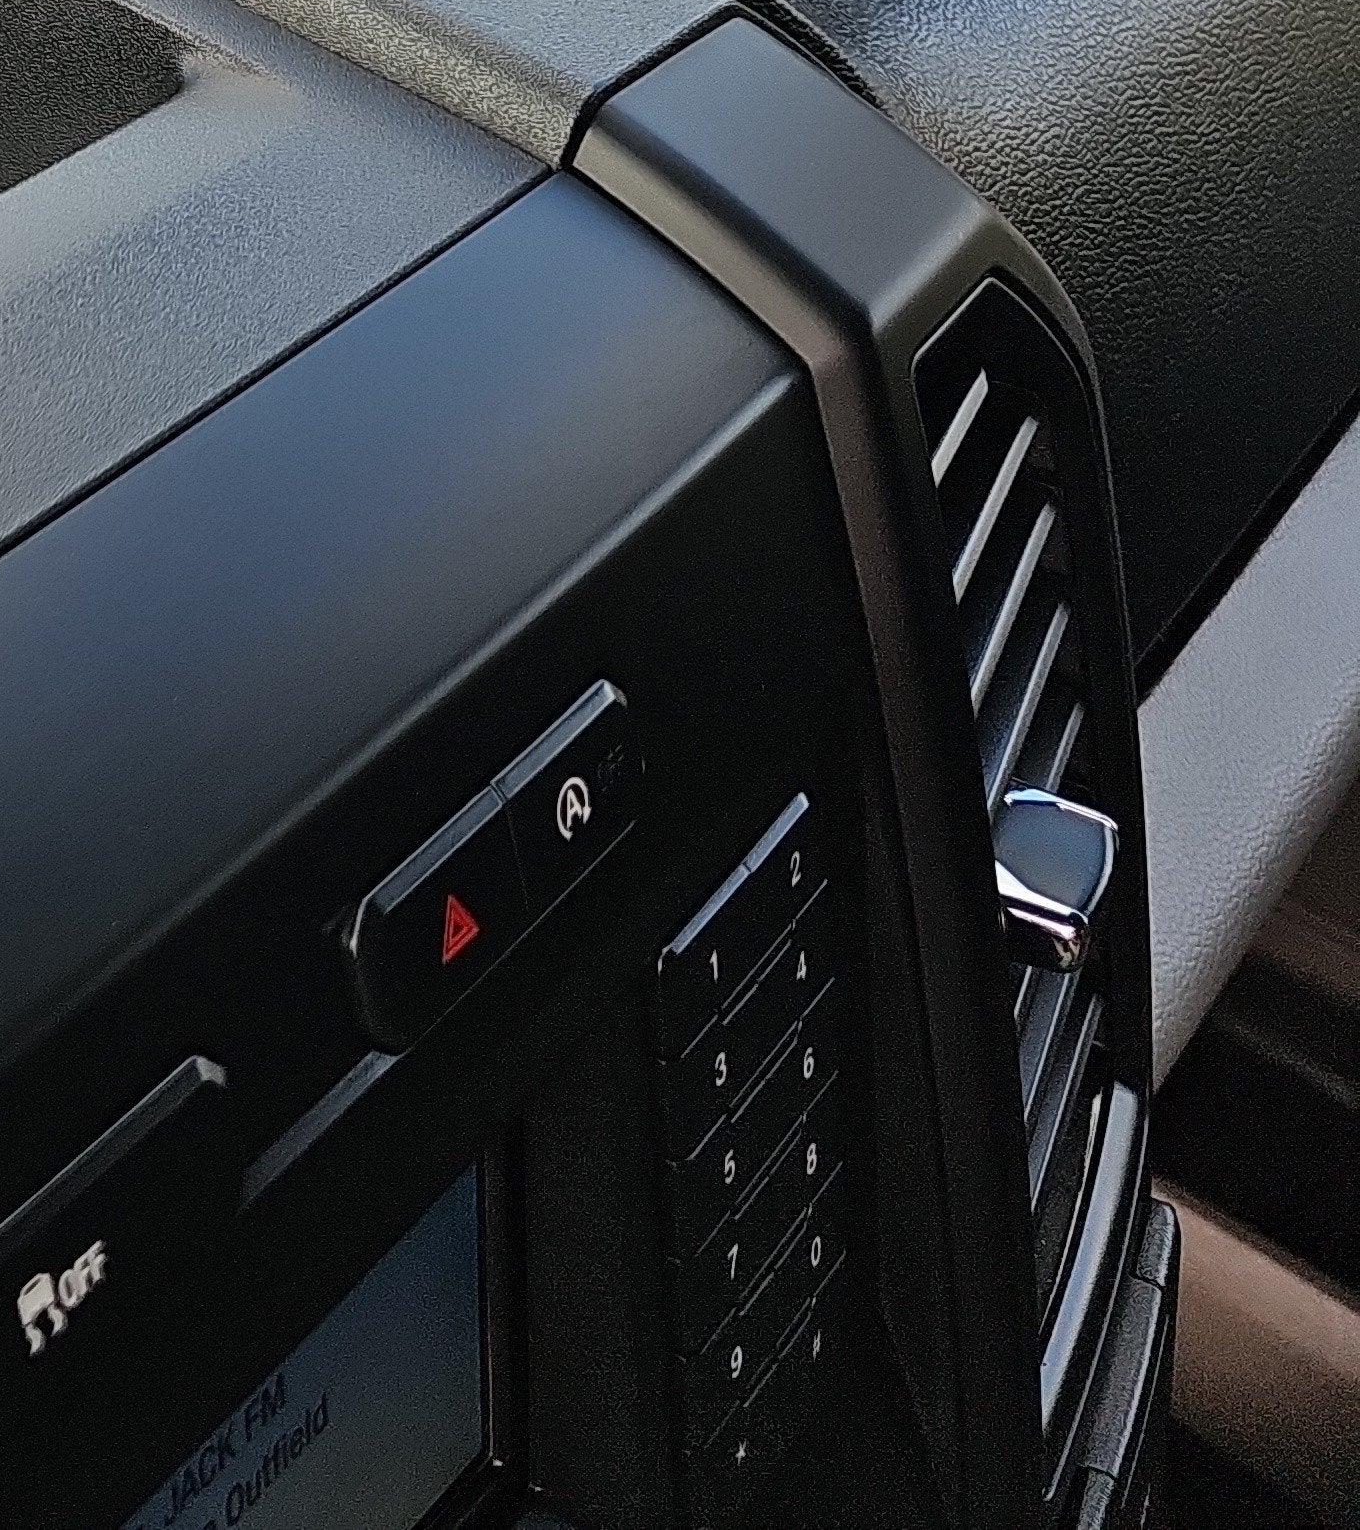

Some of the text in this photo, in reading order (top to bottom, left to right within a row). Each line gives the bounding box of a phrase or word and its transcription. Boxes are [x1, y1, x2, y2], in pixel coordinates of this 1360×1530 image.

[789, 850, 802, 888] 2
[708, 948, 719, 983] 1
[796, 950, 807, 981] 4
[714, 1051, 728, 1087] 3
[802, 1046, 815, 1080] 6
[723, 1148, 736, 1184] 5
[805, 1142, 818, 1175] 8
[726, 1242, 739, 1280] 7
[810, 1235, 822, 1268] 0
[57, 1238, 108, 1309] OFF
[730, 1345, 743, 1379] 9
[164, 1371, 285, 1527] JACK FM
[225, 1390, 330, 1527] Outfield
